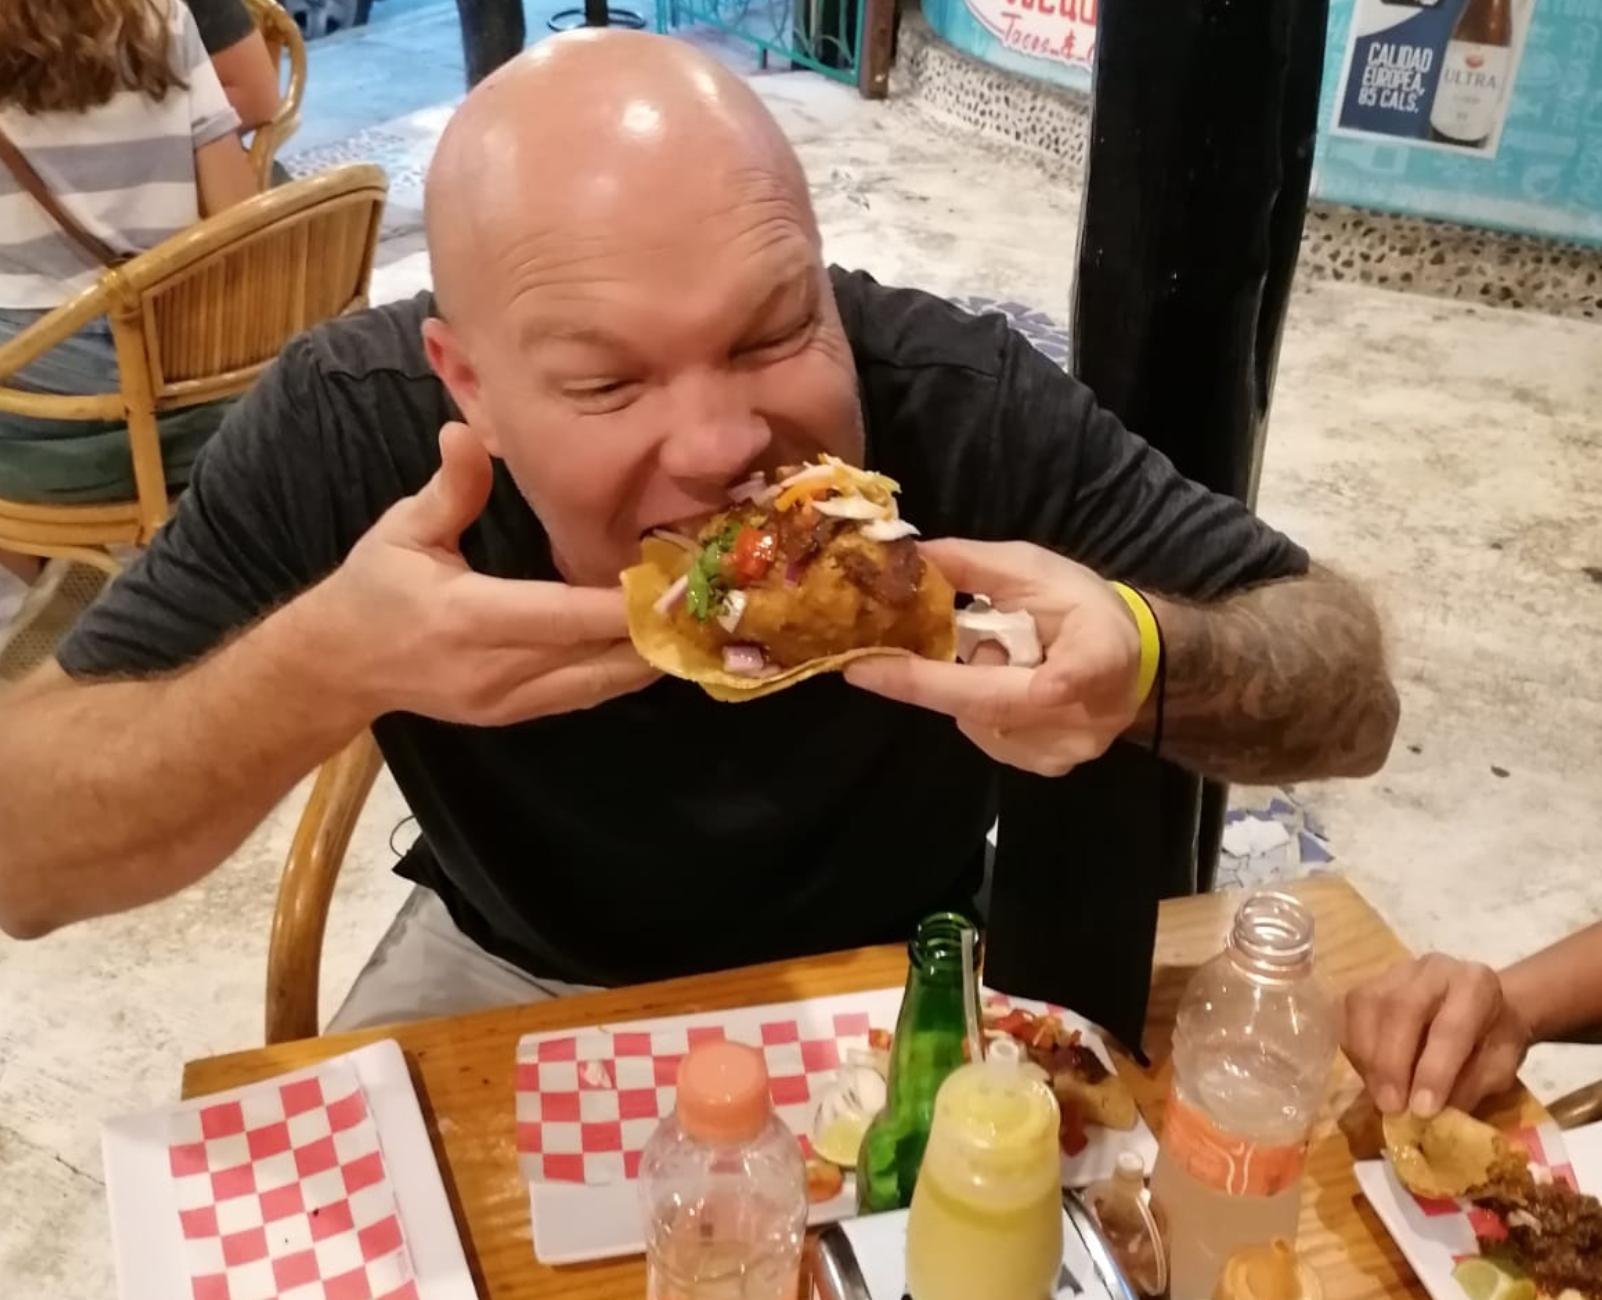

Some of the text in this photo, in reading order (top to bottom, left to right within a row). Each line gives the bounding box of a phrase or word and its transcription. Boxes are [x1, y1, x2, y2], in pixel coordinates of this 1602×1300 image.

[1368, 42, 1433, 73] CALIDAD
[1443, 67, 1497, 89] ULTRA
[1358, 87, 1419, 113] 85 CALS.
